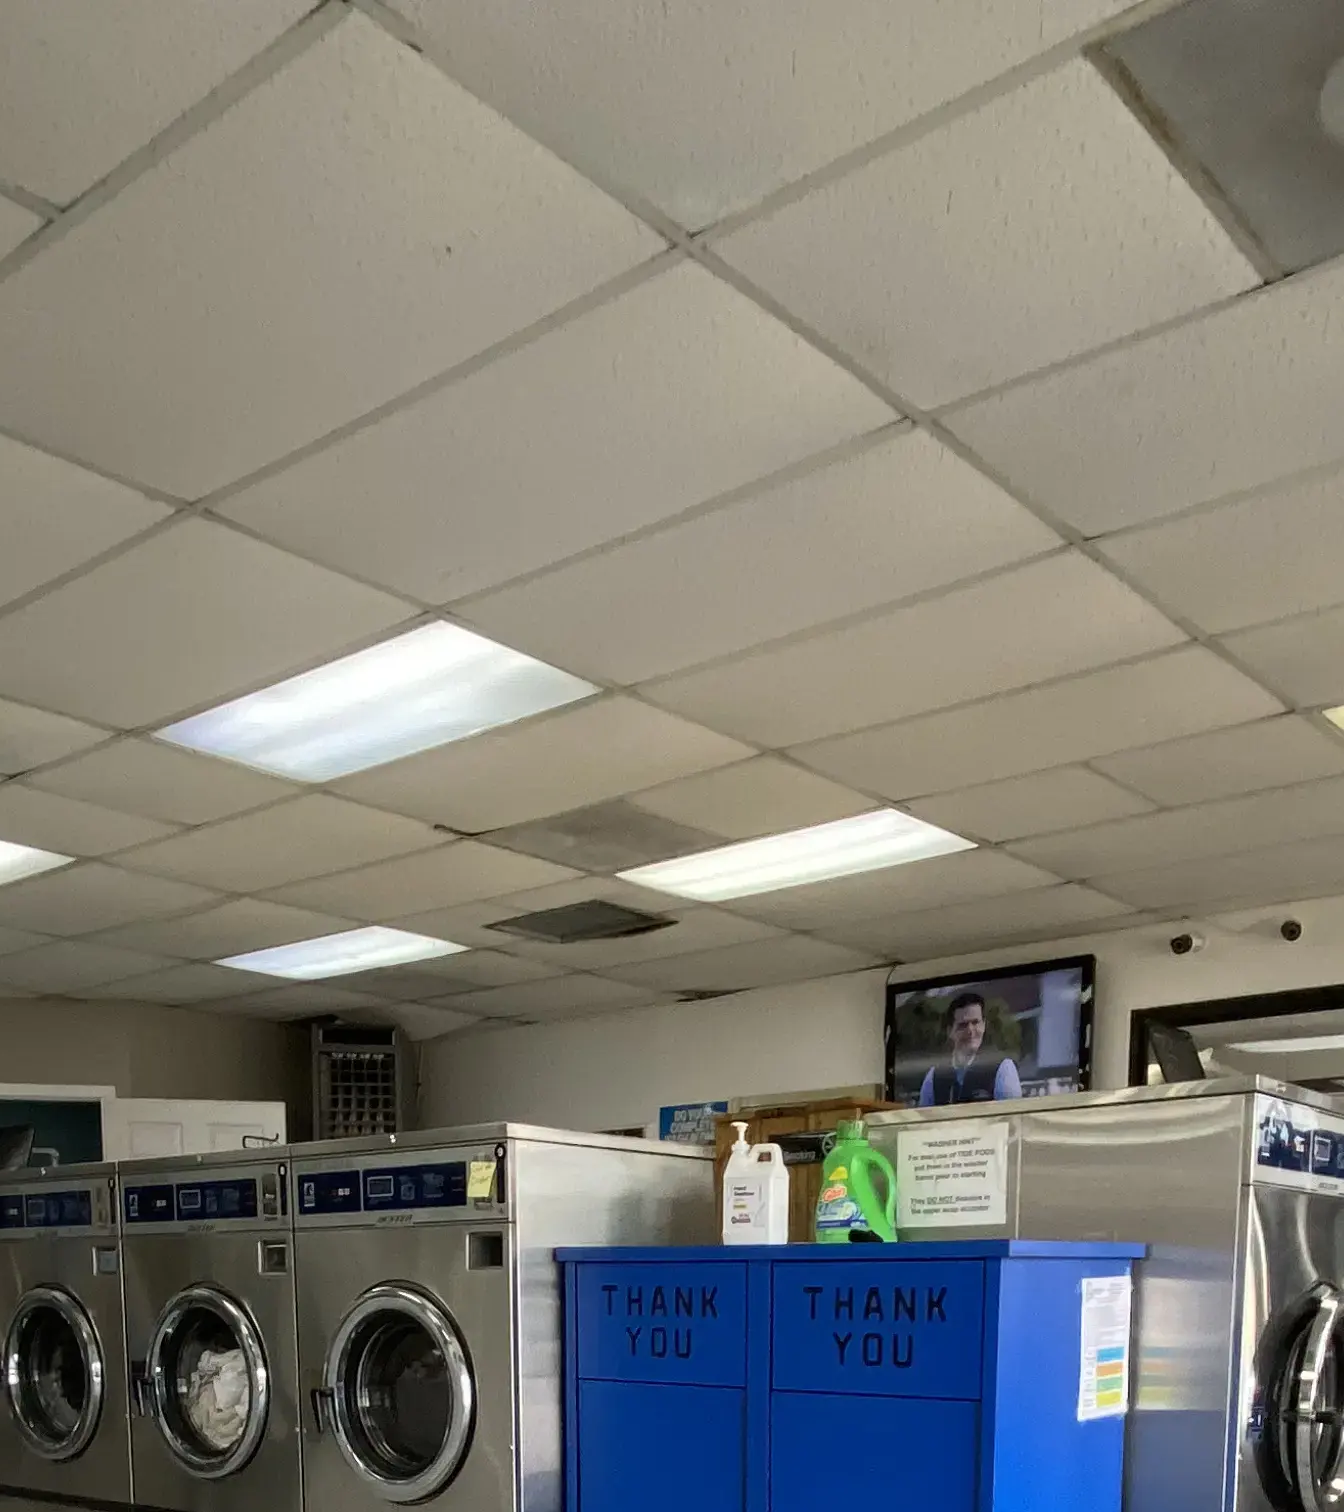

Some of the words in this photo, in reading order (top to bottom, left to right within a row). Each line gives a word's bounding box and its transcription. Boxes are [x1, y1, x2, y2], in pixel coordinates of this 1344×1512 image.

[600, 1284, 719, 1319] THANK
[802, 1286, 948, 1322] THANK
[625, 1326, 692, 1359] YOU
[832, 1332, 914, 1369] YOU
